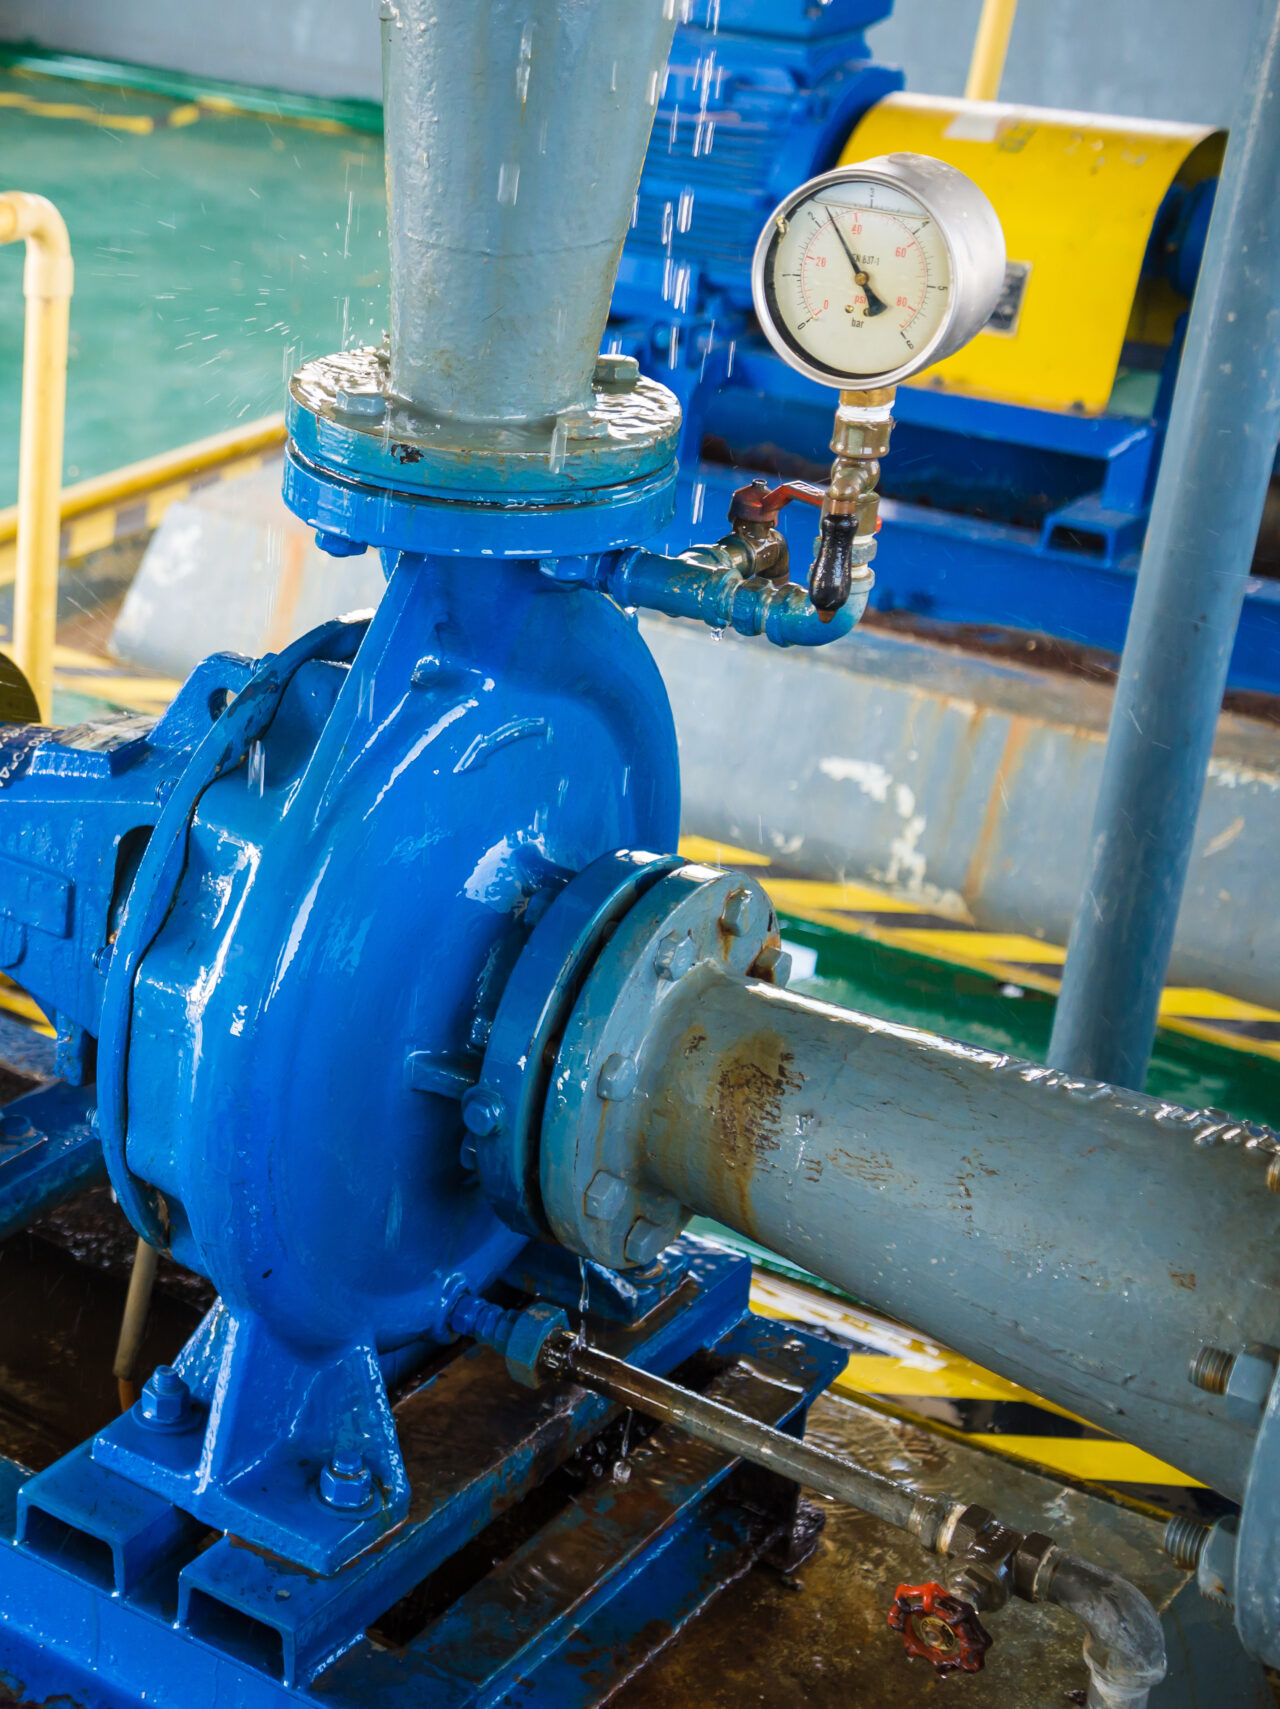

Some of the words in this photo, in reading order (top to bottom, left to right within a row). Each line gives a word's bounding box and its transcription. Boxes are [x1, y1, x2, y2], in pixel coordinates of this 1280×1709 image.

[807, 211, 817, 221] 2
[851, 224, 862, 235] 40
[895, 247, 907, 258] 60
[823, 300, 829, 310] 0
[896, 296, 908, 307] 80
[797, 322, 806, 331] 0
[851, 318, 864, 328] bar
